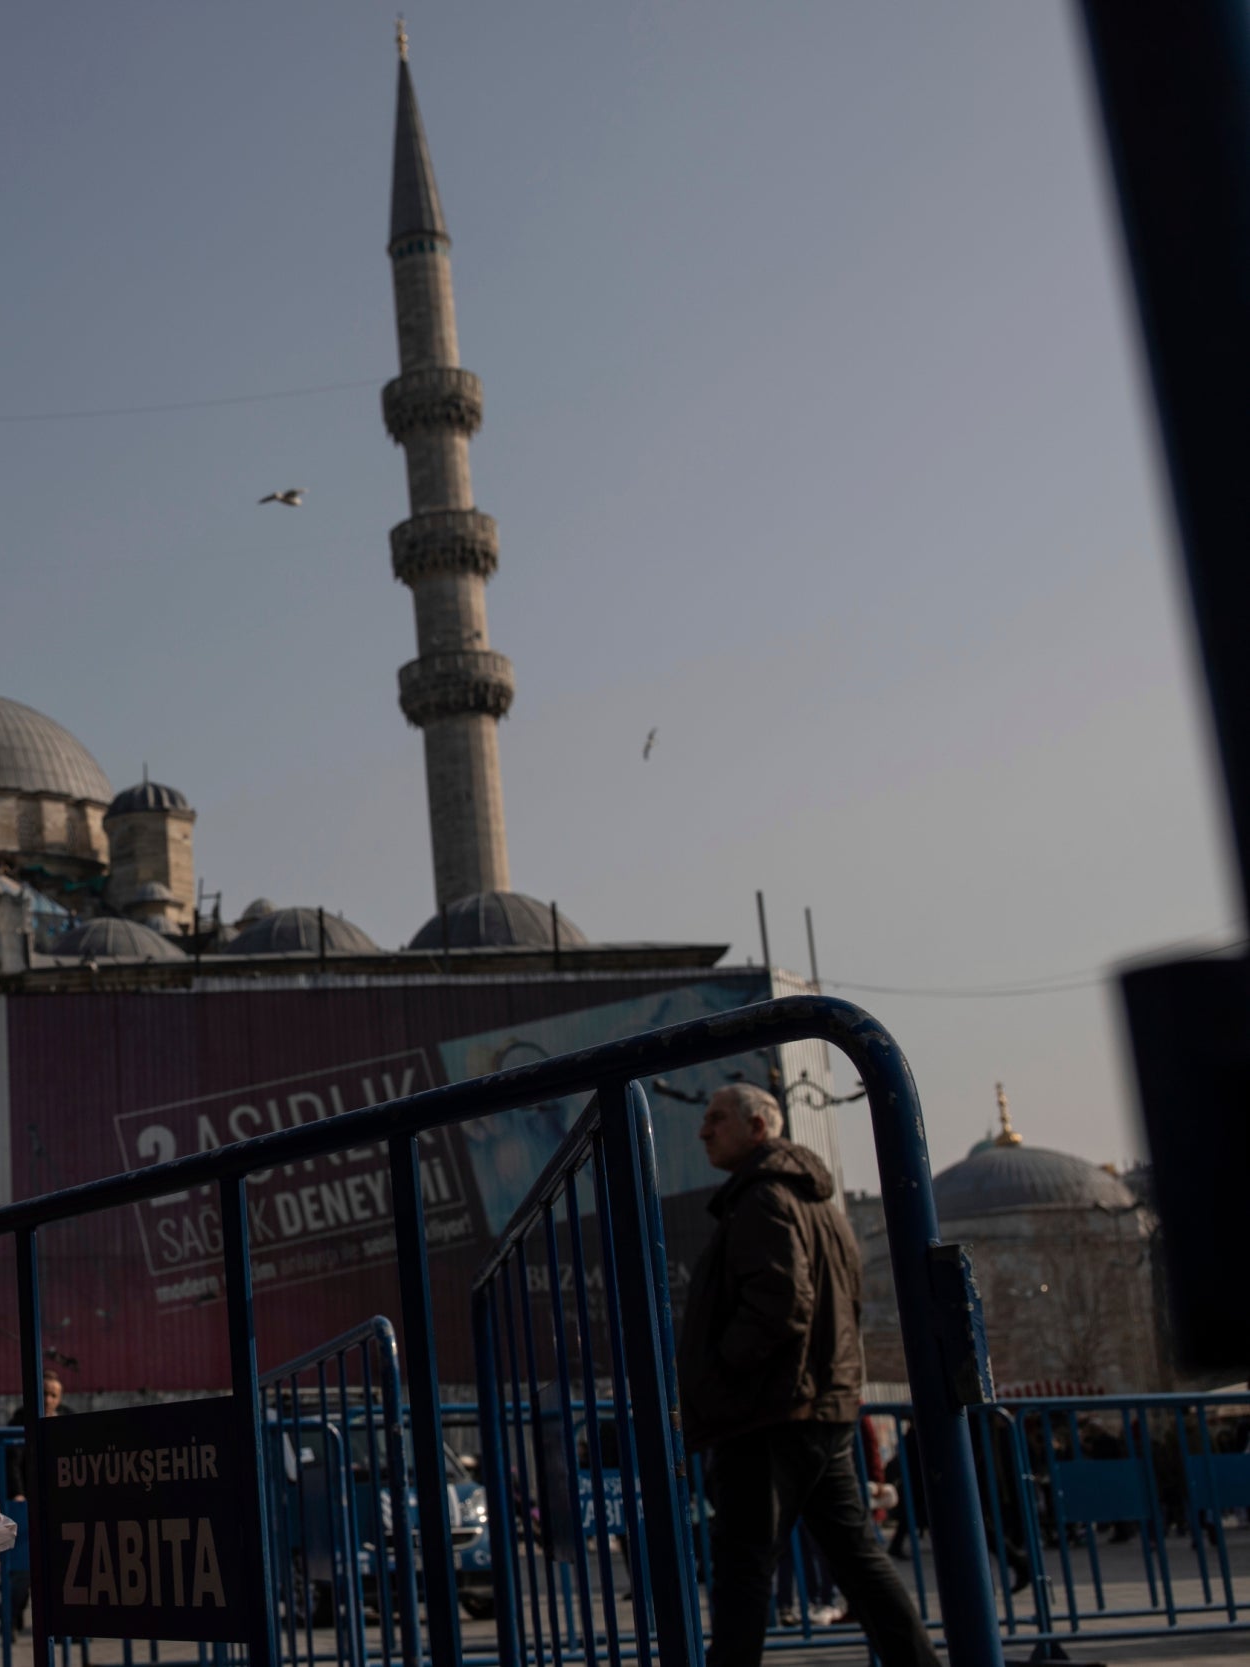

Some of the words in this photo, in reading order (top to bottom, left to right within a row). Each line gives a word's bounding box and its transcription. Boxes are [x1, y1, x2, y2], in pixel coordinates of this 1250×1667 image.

[137, 1124, 190, 1207] 2
[156, 1199, 276, 1263] SAĞK
[275, 1157, 452, 1238] DENEYMİ
[155, 1276, 220, 1303] modern
[57, 1435, 219, 1491] BÜYÜKŞEHİR
[61, 1516, 227, 1608] ZABITA
